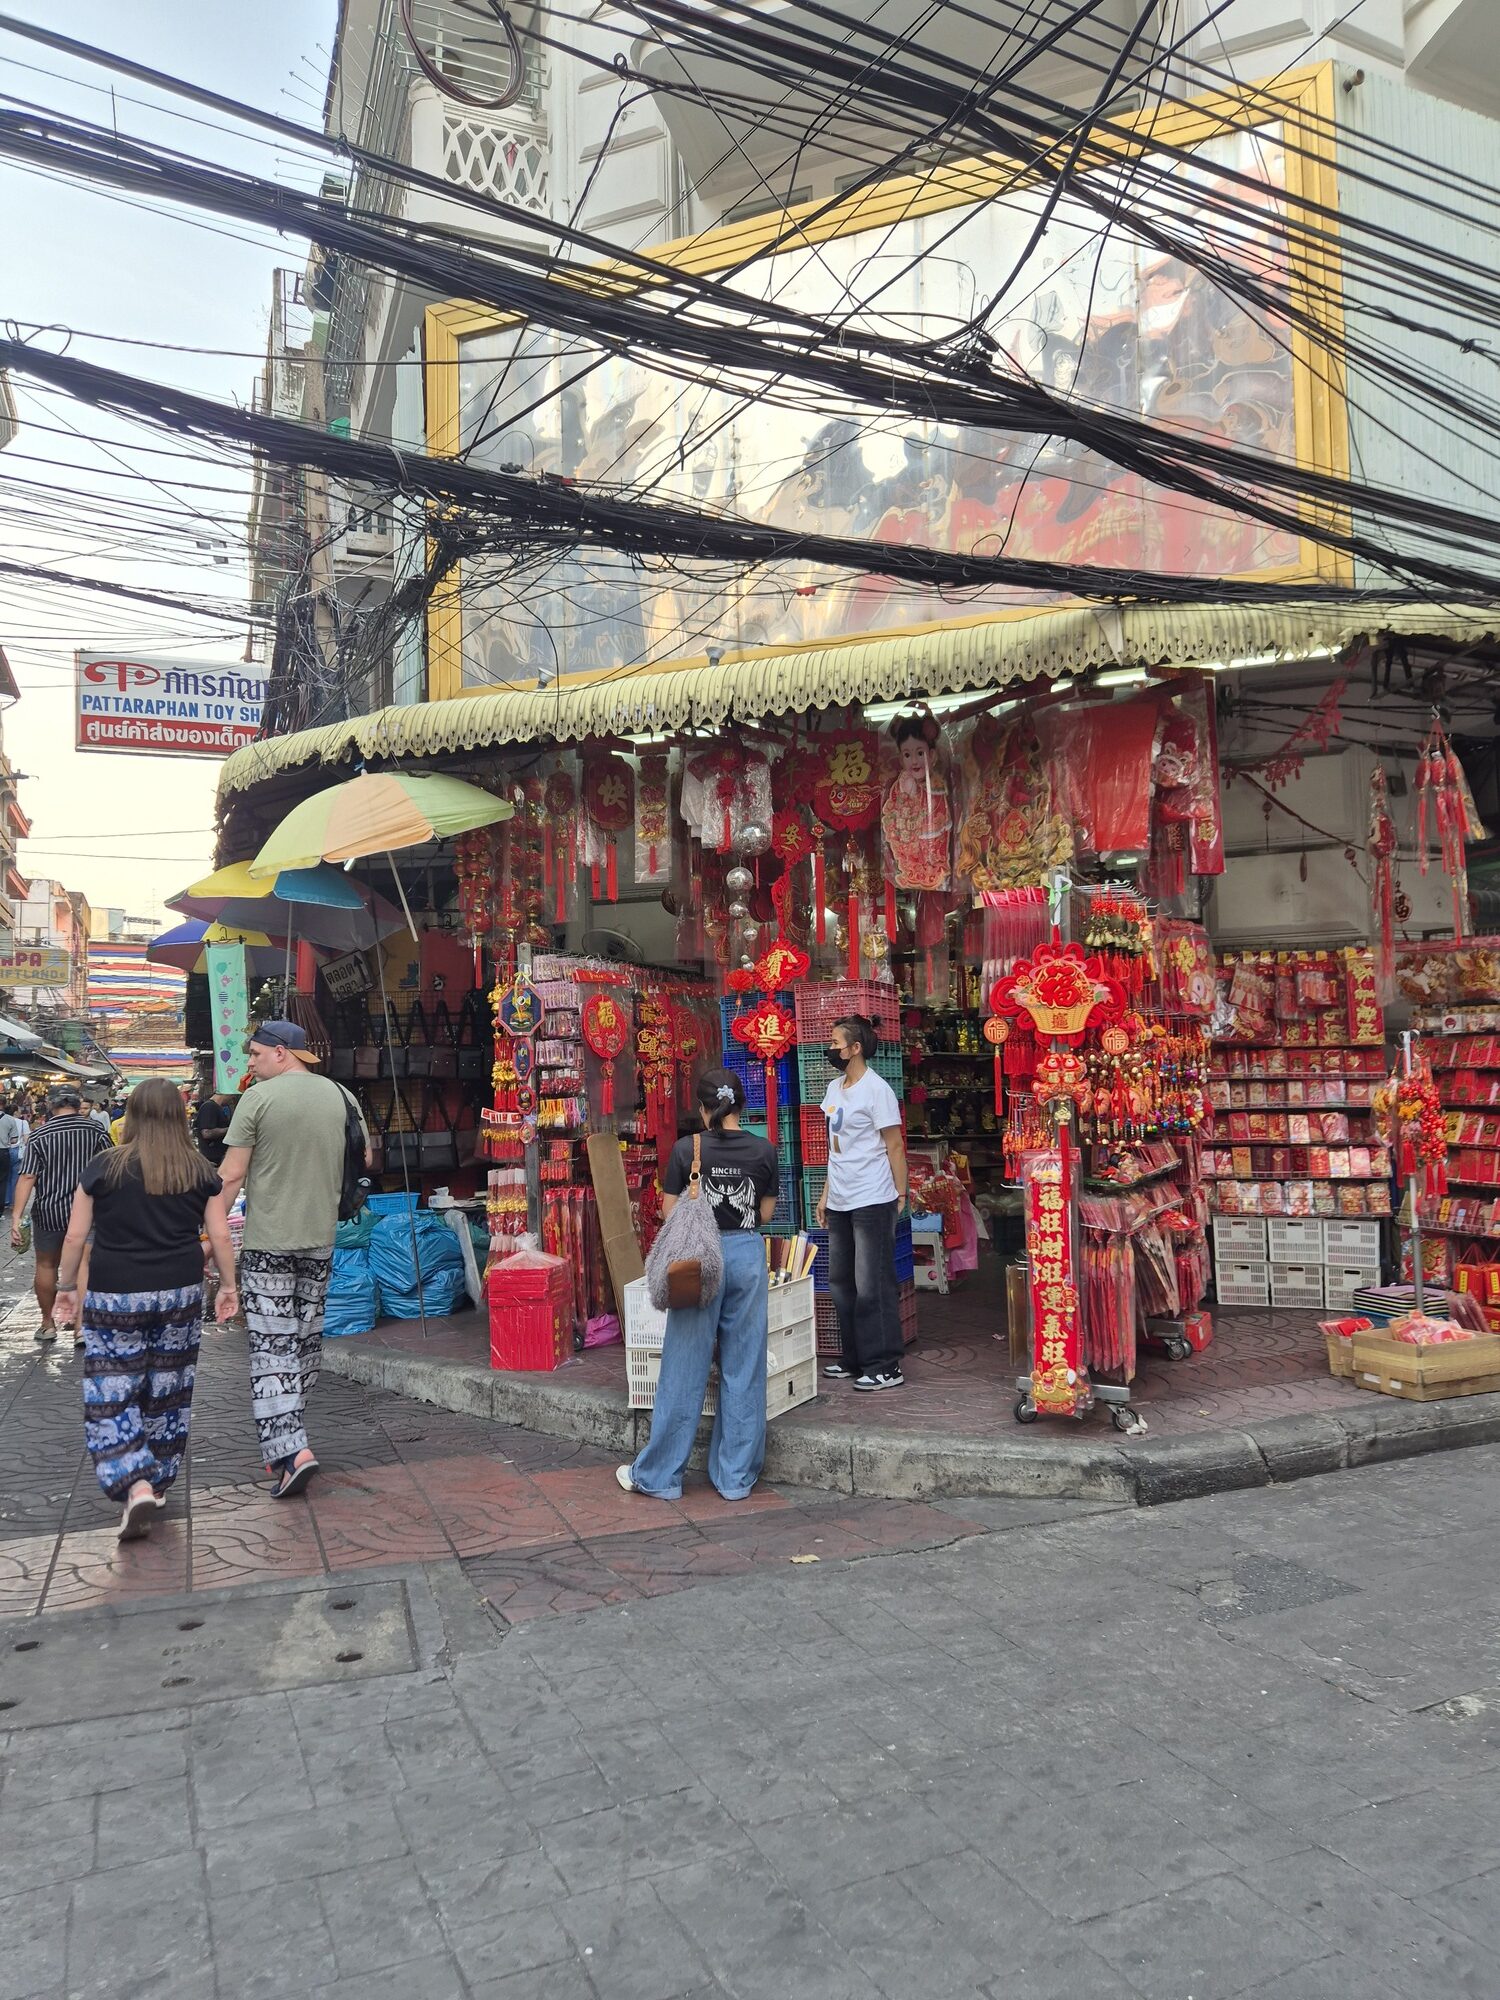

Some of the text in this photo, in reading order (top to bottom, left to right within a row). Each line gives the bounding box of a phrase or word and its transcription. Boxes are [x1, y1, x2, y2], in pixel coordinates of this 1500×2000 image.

[82, 694, 261, 723] PATTARAPHAN TOY SH
[830, 741, 871, 785] 福
[1037, 965, 1082, 1008] 福
[987, 1020, 1006, 1040] 福
[1105, 1032, 1125, 1050] 福
[711, 1166, 742, 1175] SINCERE
[1038, 1185, 1069, 1364] 福旺財旺運氣旺
